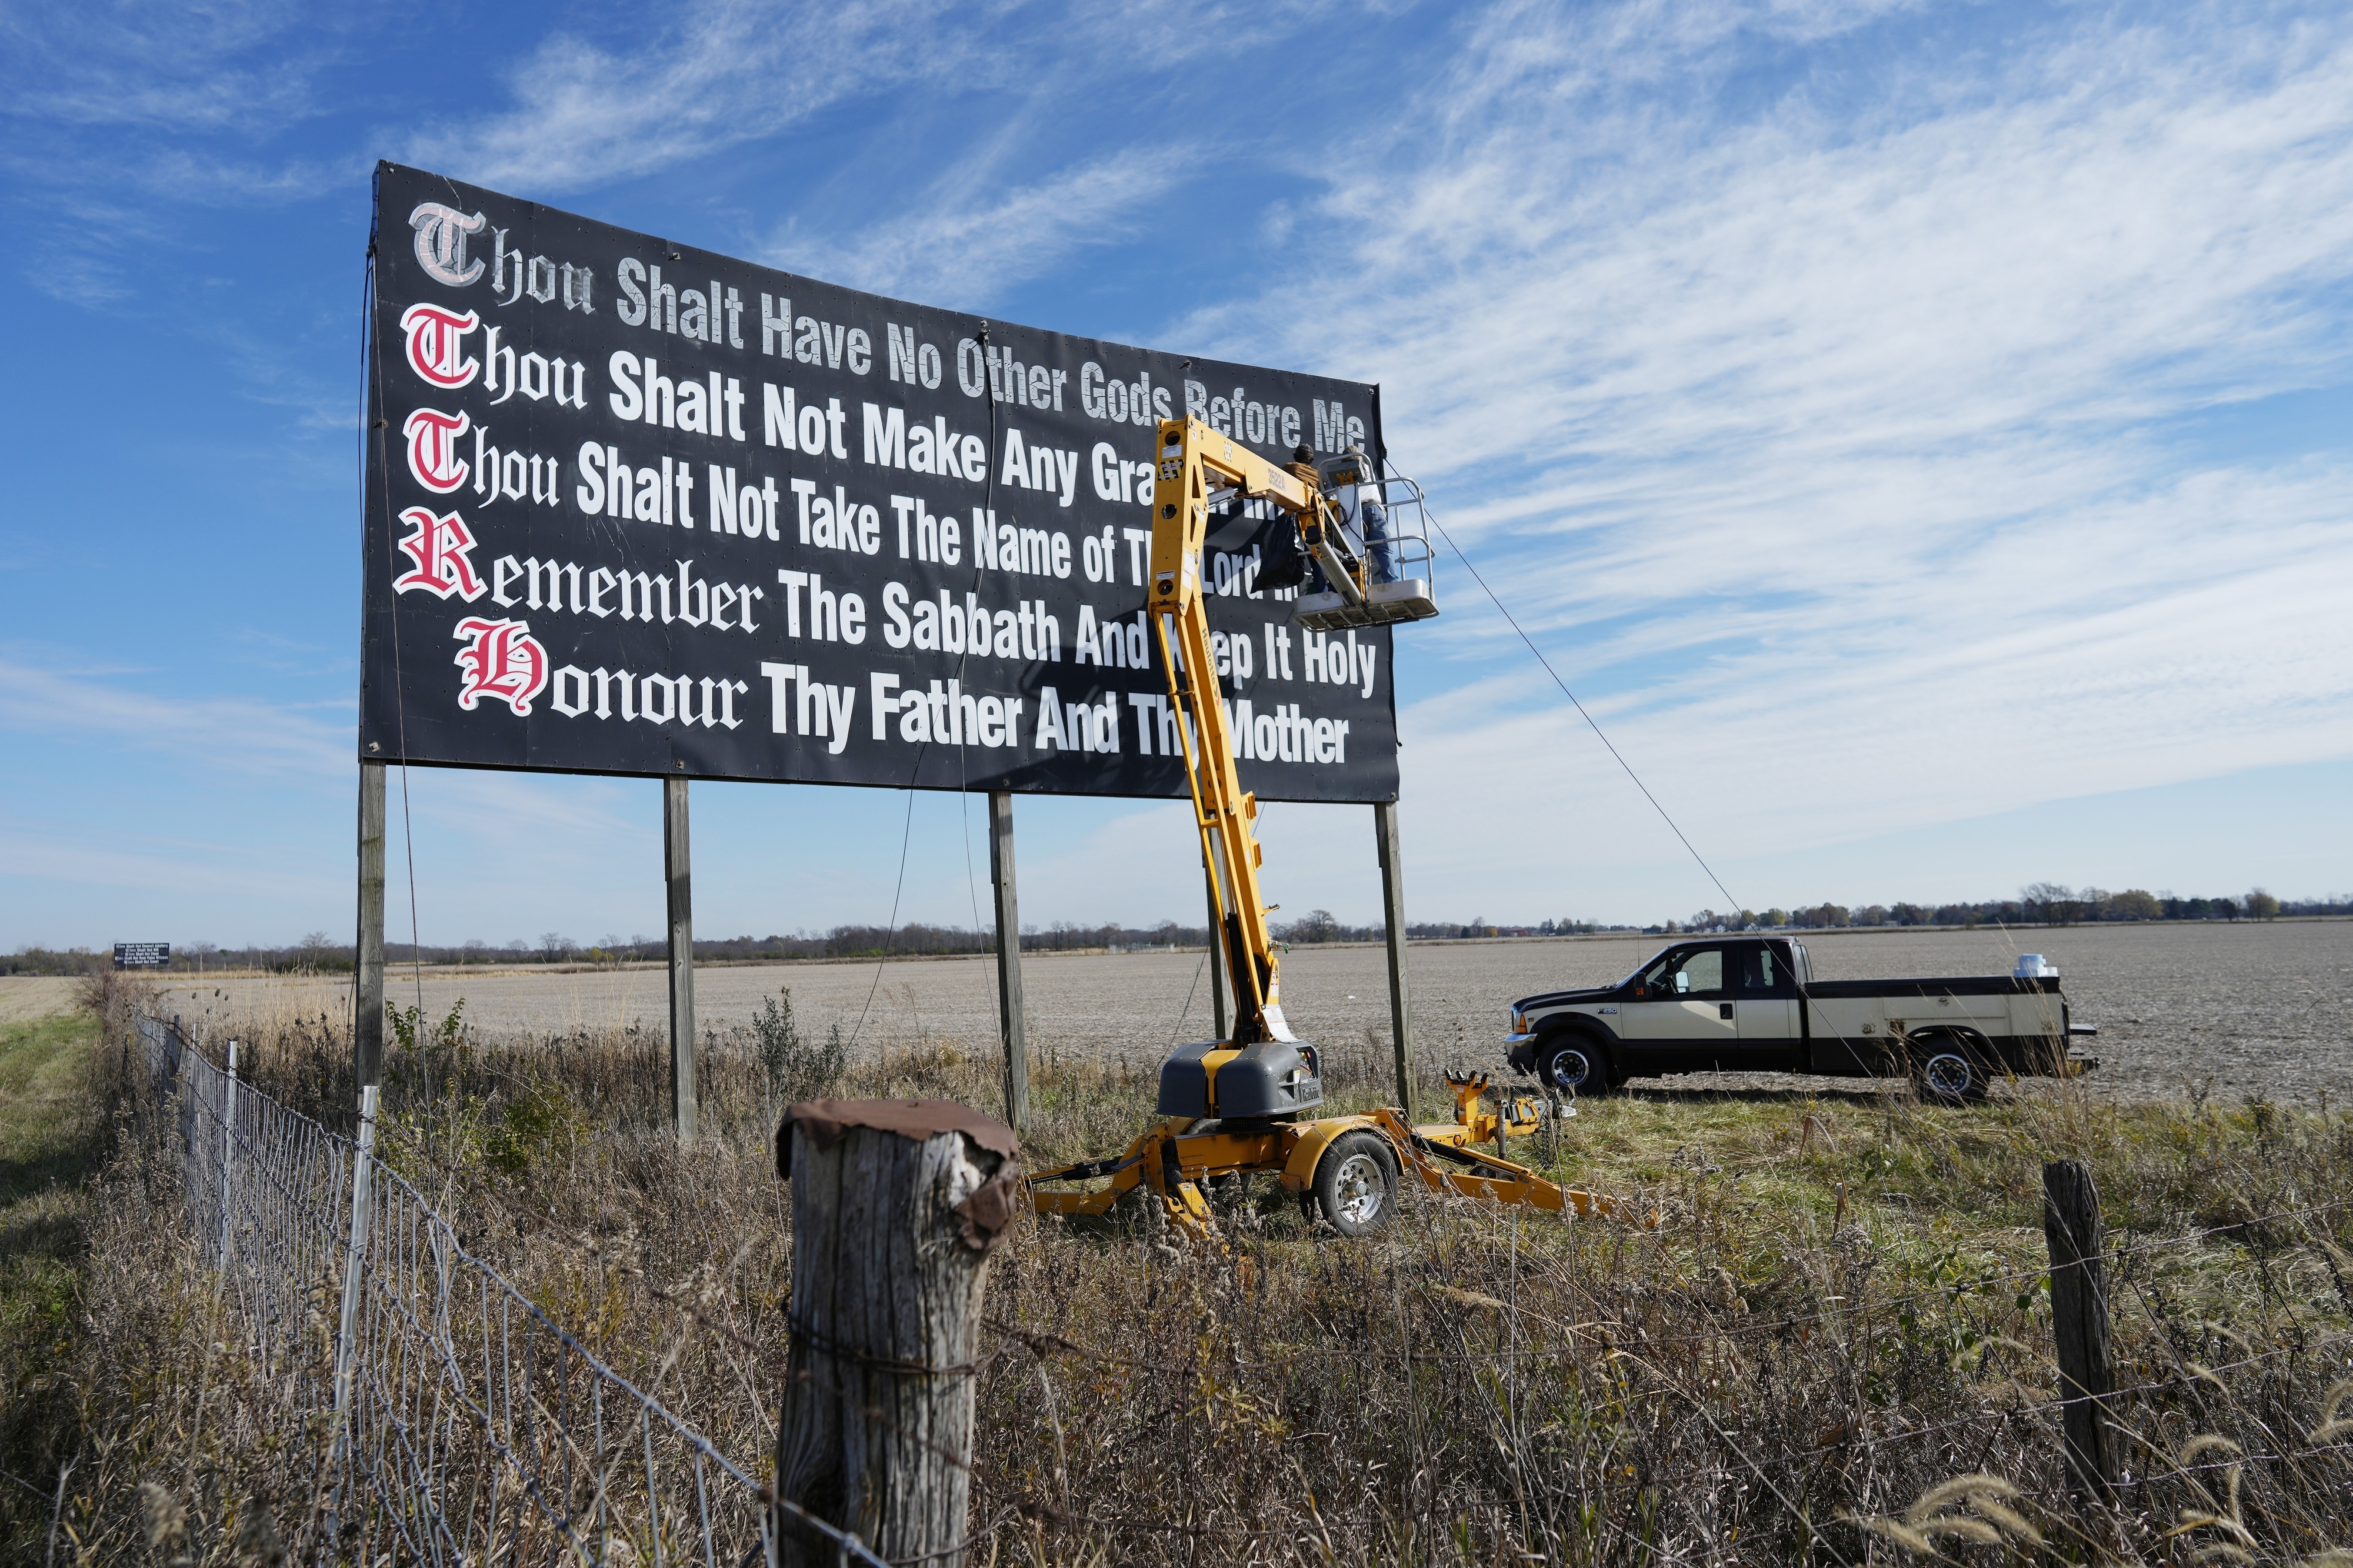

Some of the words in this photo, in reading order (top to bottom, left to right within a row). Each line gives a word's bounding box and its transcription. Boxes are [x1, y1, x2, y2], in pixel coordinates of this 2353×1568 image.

[399, 302, 588, 410] Thou
[609, 351, 745, 441] Shalt
[764, 382, 847, 459] Not
[862, 402, 986, 482] Make
[1001, 428, 1078, 508] Any
[408, 202, 595, 315] Thou
[617, 257, 744, 349] Shalt
[761, 292, 872, 375] Have
[887, 322, 941, 389] No
[957, 338, 1067, 412] Other
[1081, 362, 1173, 427] Gods
[1184, 379, 1301, 448] Before
[1312, 398, 1365, 453] Me
[402, 408, 560, 509] Thou
[576, 441, 694, 528] Shalt
[709, 464, 779, 541] Not
[791, 478, 880, 555] Take
[891, 495, 961, 566] The
[972, 507, 1071, 579] Name
[1083, 525, 1115, 583] of
[1198, 543, 1264, 600] Lord
[1268, 468, 1286, 492] 3522A
[392, 506, 764, 634] Remember
[778, 569, 866, 645] The
[883, 582, 1061, 662] Sabbath
[1075, 605, 1149, 669] And
[1162, 613, 1253, 690] Kep
[1265, 623, 1293, 680] It
[1303, 628, 1376, 699] Holy
[452, 617, 749, 730] Honour
[761, 662, 855, 755] Thy
[871, 672, 1022, 748] Father
[1035, 686, 1119, 753] And
[1222, 699, 1349, 763] Mother
[1202, 628, 1215, 685] Haulotte
